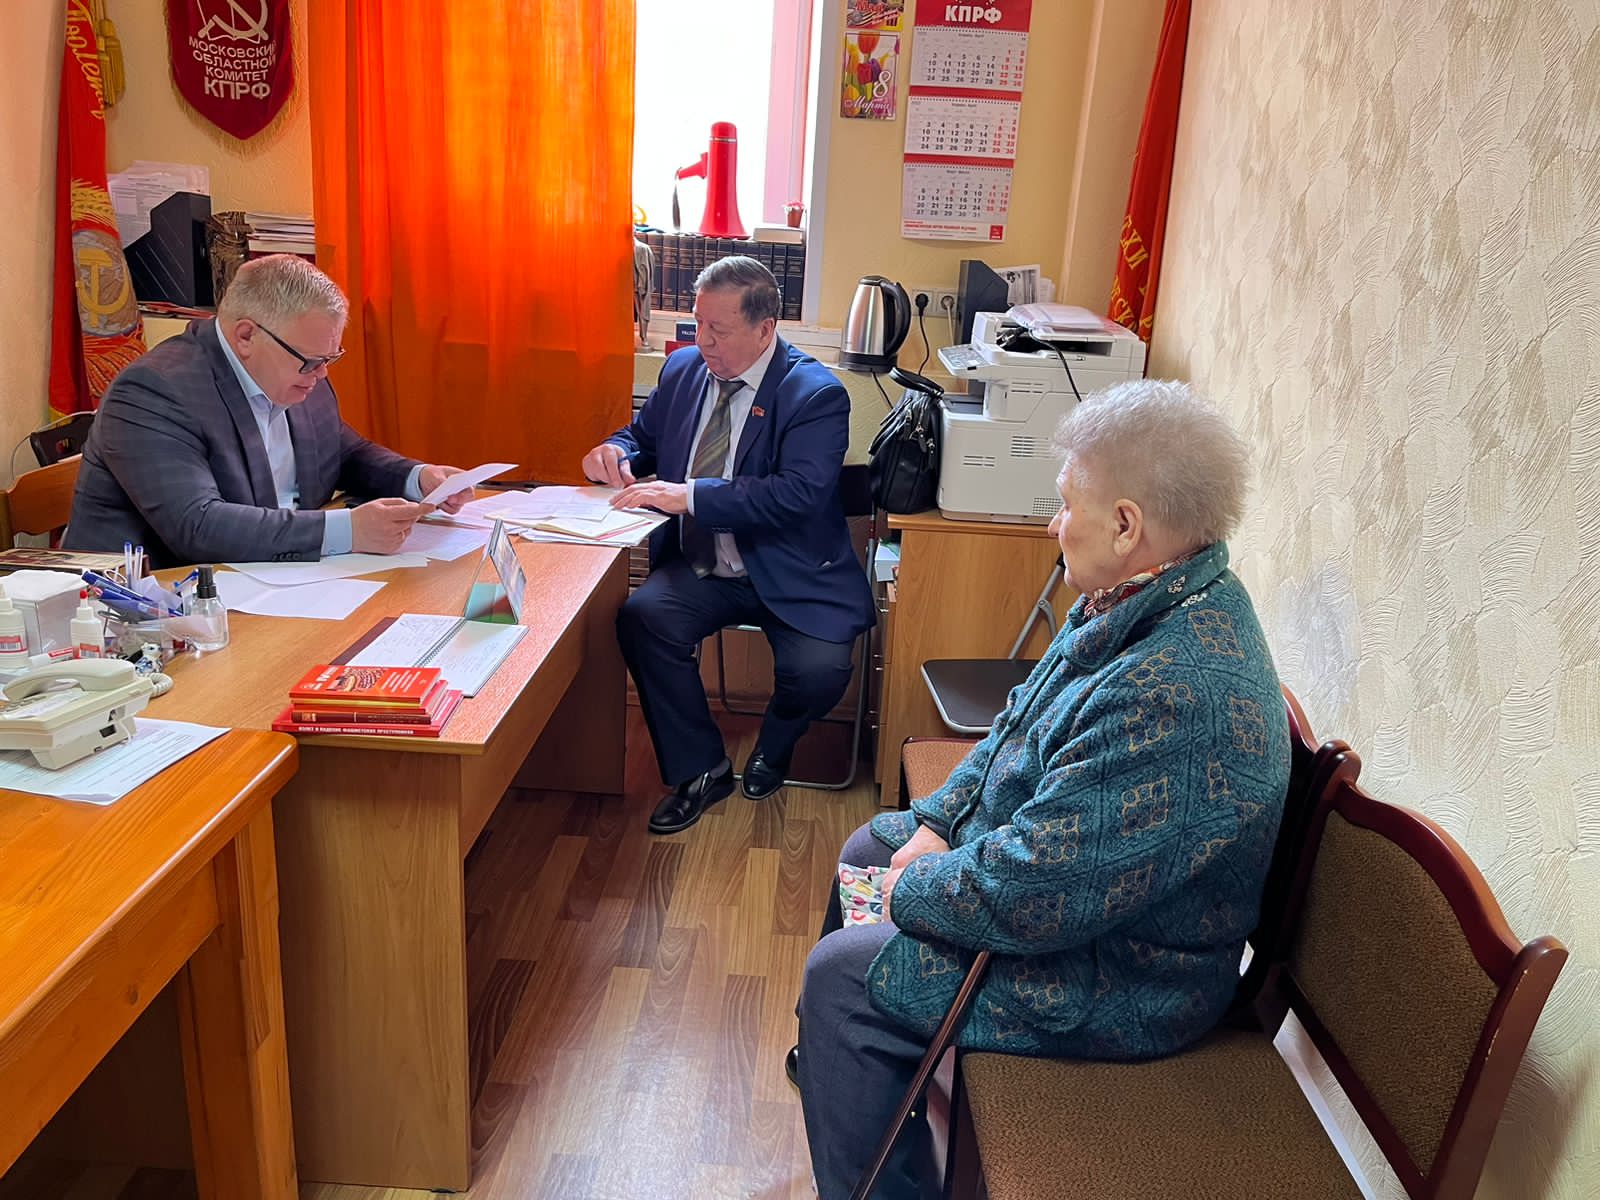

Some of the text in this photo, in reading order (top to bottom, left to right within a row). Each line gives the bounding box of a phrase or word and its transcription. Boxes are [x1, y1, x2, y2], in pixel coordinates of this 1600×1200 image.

[944, 5, 1002, 23] КПРФ
[188, 35, 277, 58] МОСКОВСКИЙ
[192, 50, 277, 70] ОБЛАСТНОЙ
[205, 66, 269, 82] КОМИТЕТ
[872, 70, 892, 98] 8
[203, 76, 271, 100] КПРФ
[852, 95, 890, 113] Марта
